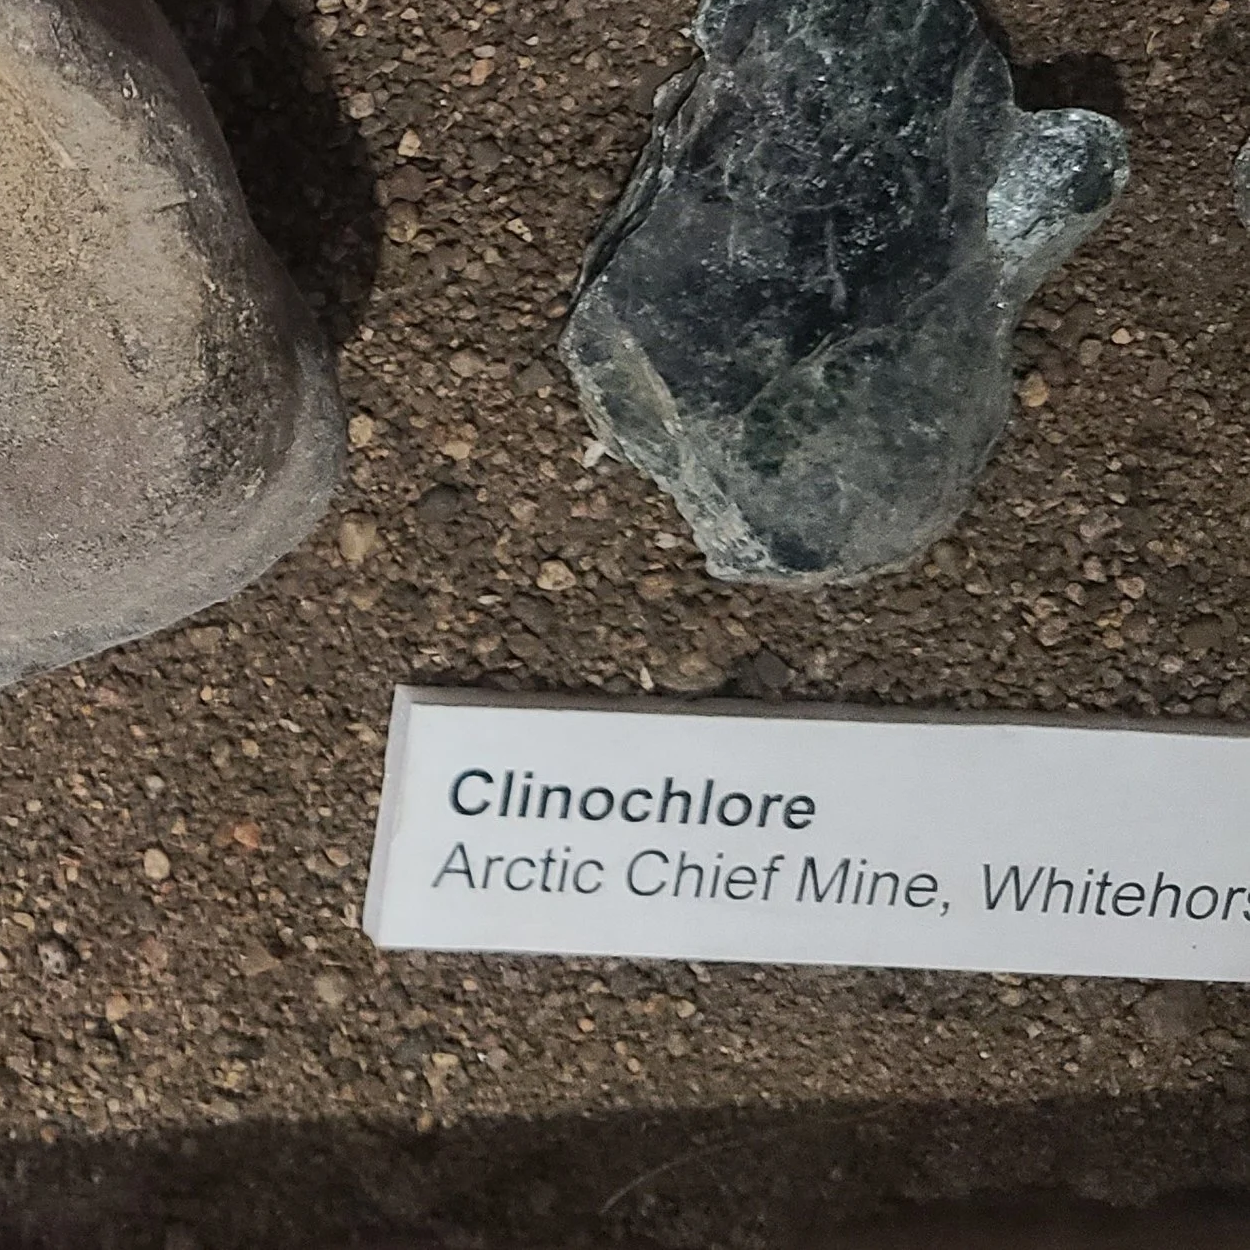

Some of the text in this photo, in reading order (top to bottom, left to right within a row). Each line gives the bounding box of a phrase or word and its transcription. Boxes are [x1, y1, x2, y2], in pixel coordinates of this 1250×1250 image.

[448, 767, 817, 831] Clinochlore
[430, 841, 1250, 922] Arctic Chief Mine, Whitehor
